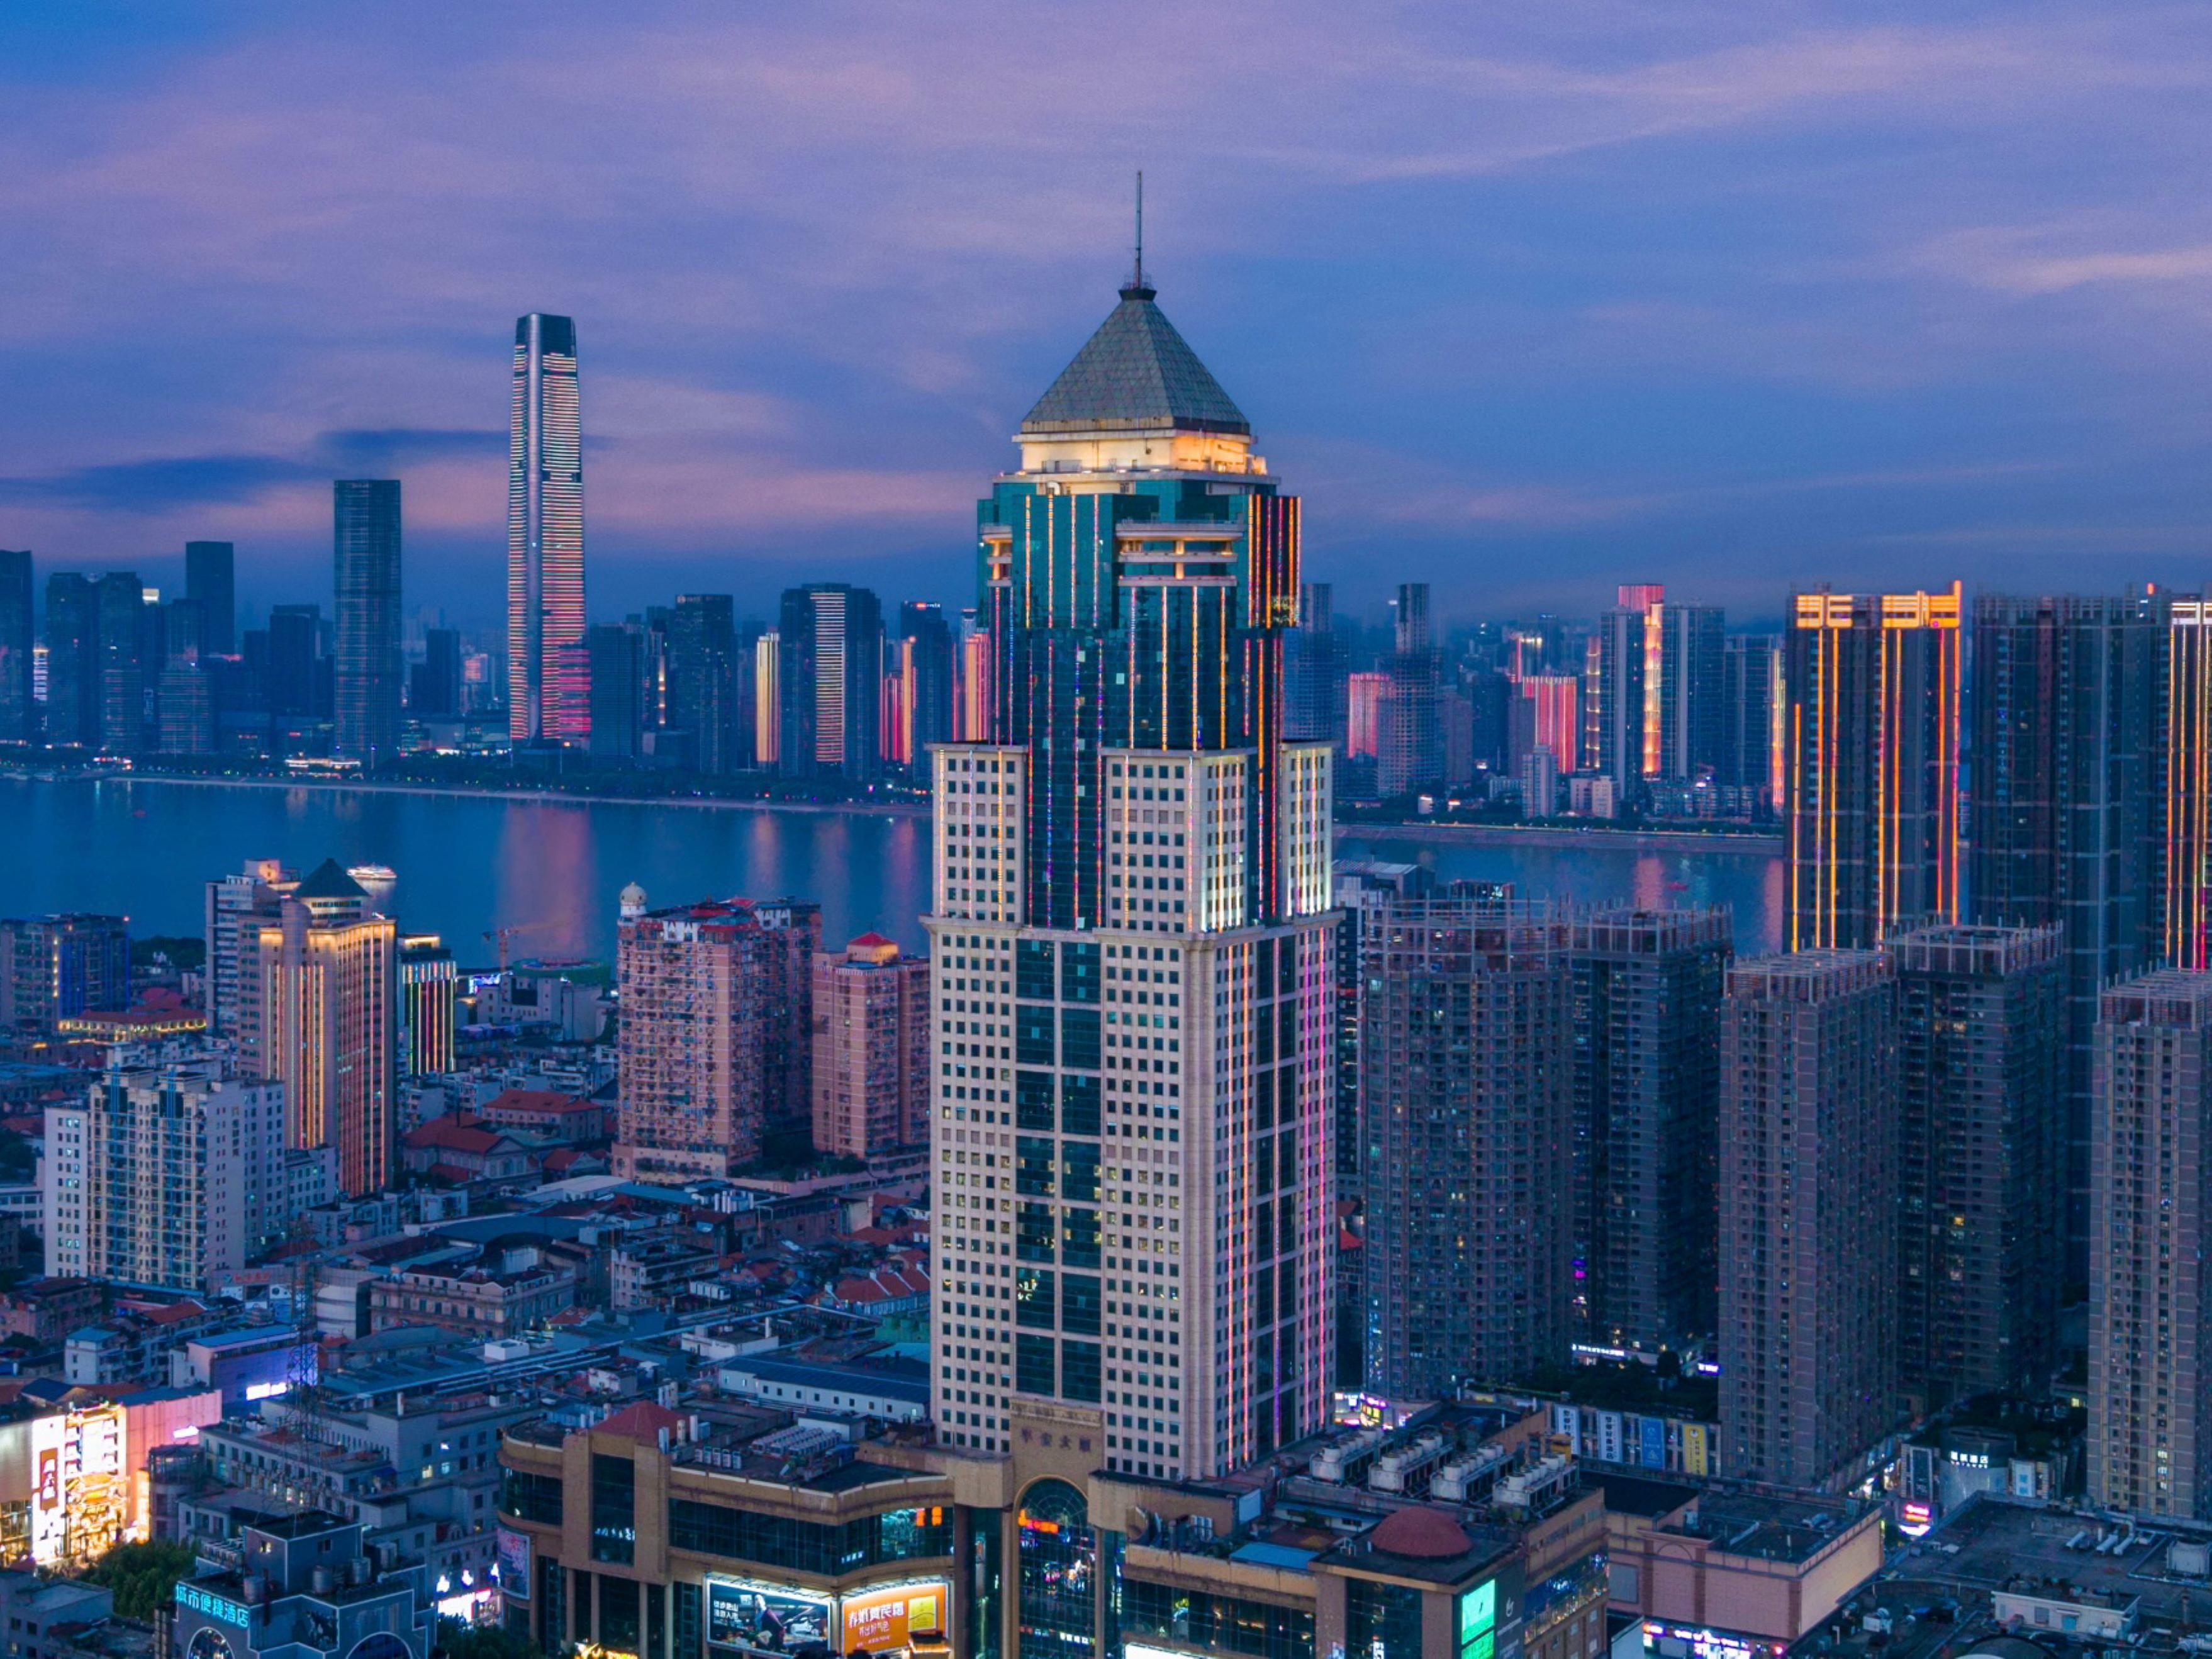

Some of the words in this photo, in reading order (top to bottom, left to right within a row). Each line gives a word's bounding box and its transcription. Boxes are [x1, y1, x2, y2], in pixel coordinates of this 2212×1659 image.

[176, 1584, 249, 1628] 城市便捷酒店
